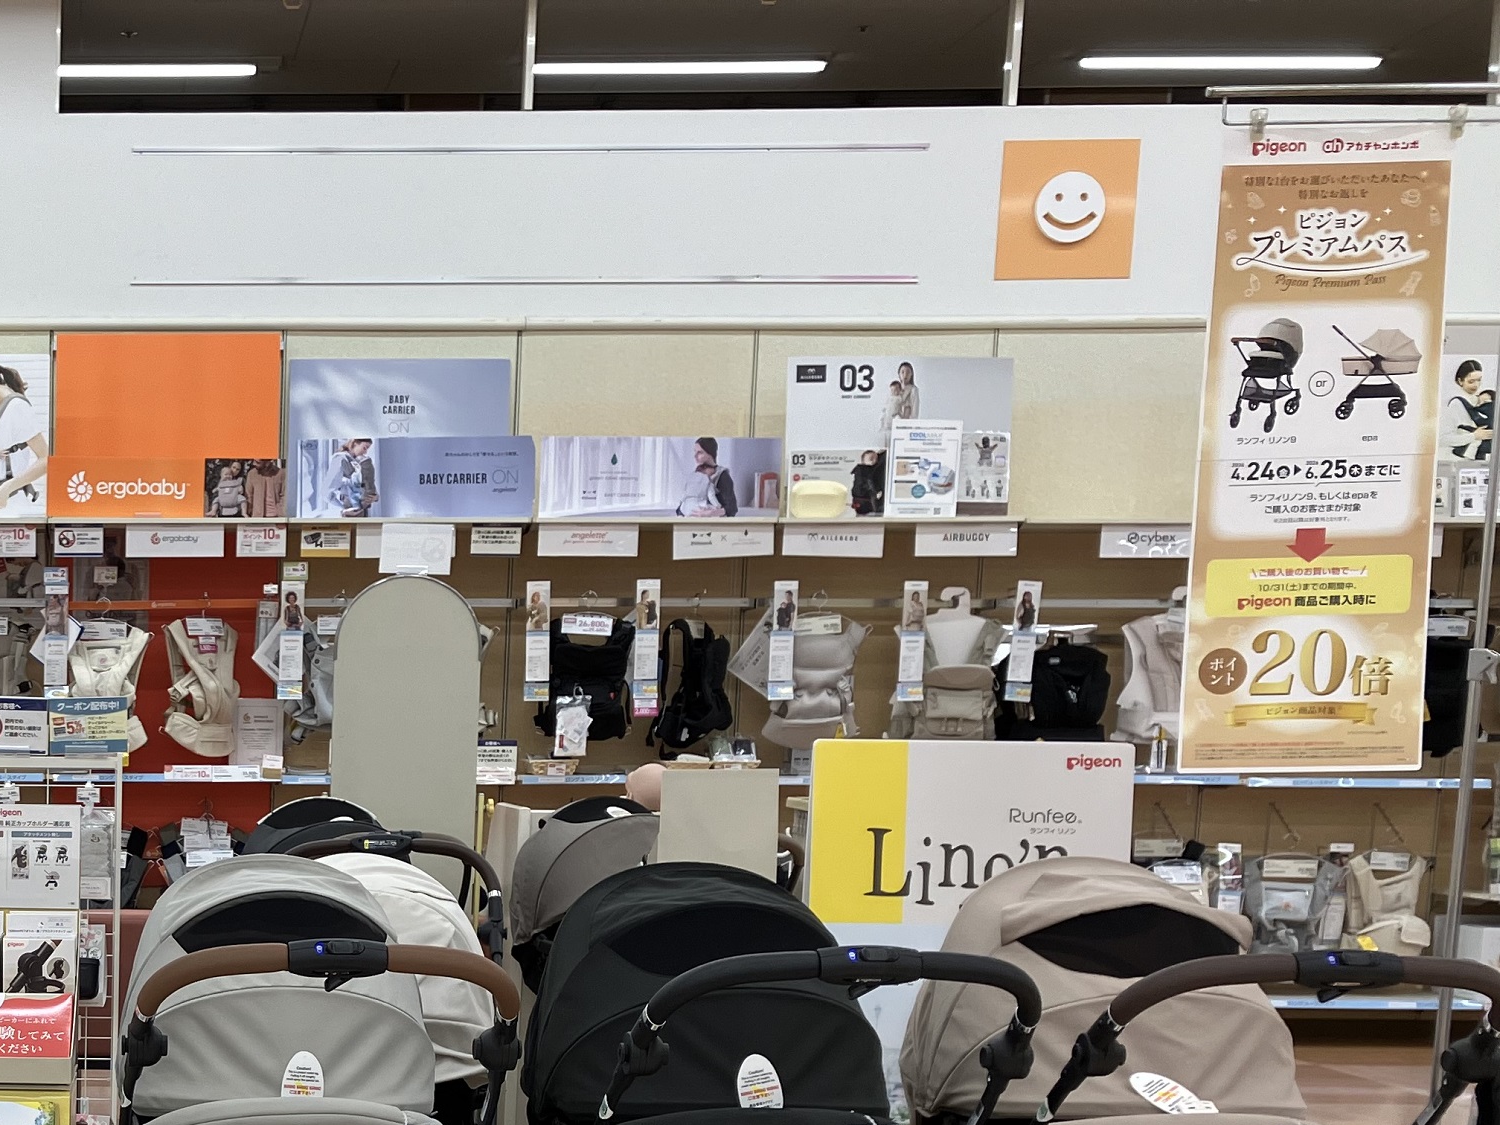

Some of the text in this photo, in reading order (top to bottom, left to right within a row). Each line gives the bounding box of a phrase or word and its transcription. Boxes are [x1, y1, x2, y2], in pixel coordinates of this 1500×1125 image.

[1252, 139, 1419, 156] pigeon アカチャンホンポ
[1299, 213, 1367, 230] ピジョン
[1253, 232, 1408, 257] プレミアムパス
[1275, 274, 1386, 291] Pigeon Premium Pass
[839, 364, 874, 392] 03
[1316, 378, 1327, 387] or
[389, 395, 409, 404] BABY
[383, 405, 415, 414] CARRIER
[1362, 435, 1378, 443] epa
[419, 473, 444, 484] BABY
[447, 473, 487, 484] CARRIER
[96, 478, 186, 500] ergobaby
[1265, 503, 1361, 514] ご購入のお客さまが対象
[162, 535, 198, 544] ergobaby
[943, 533, 990, 542] AIRBUGGY
[1140, 531, 1176, 544] cybex
[1238, 594, 1376, 610] pigeon 商品ご購入時に
[57, 701, 120, 711] クーポン配布中!
[1067, 753, 1122, 770] pigeon
[0, 1043, 42, 1054] ください
